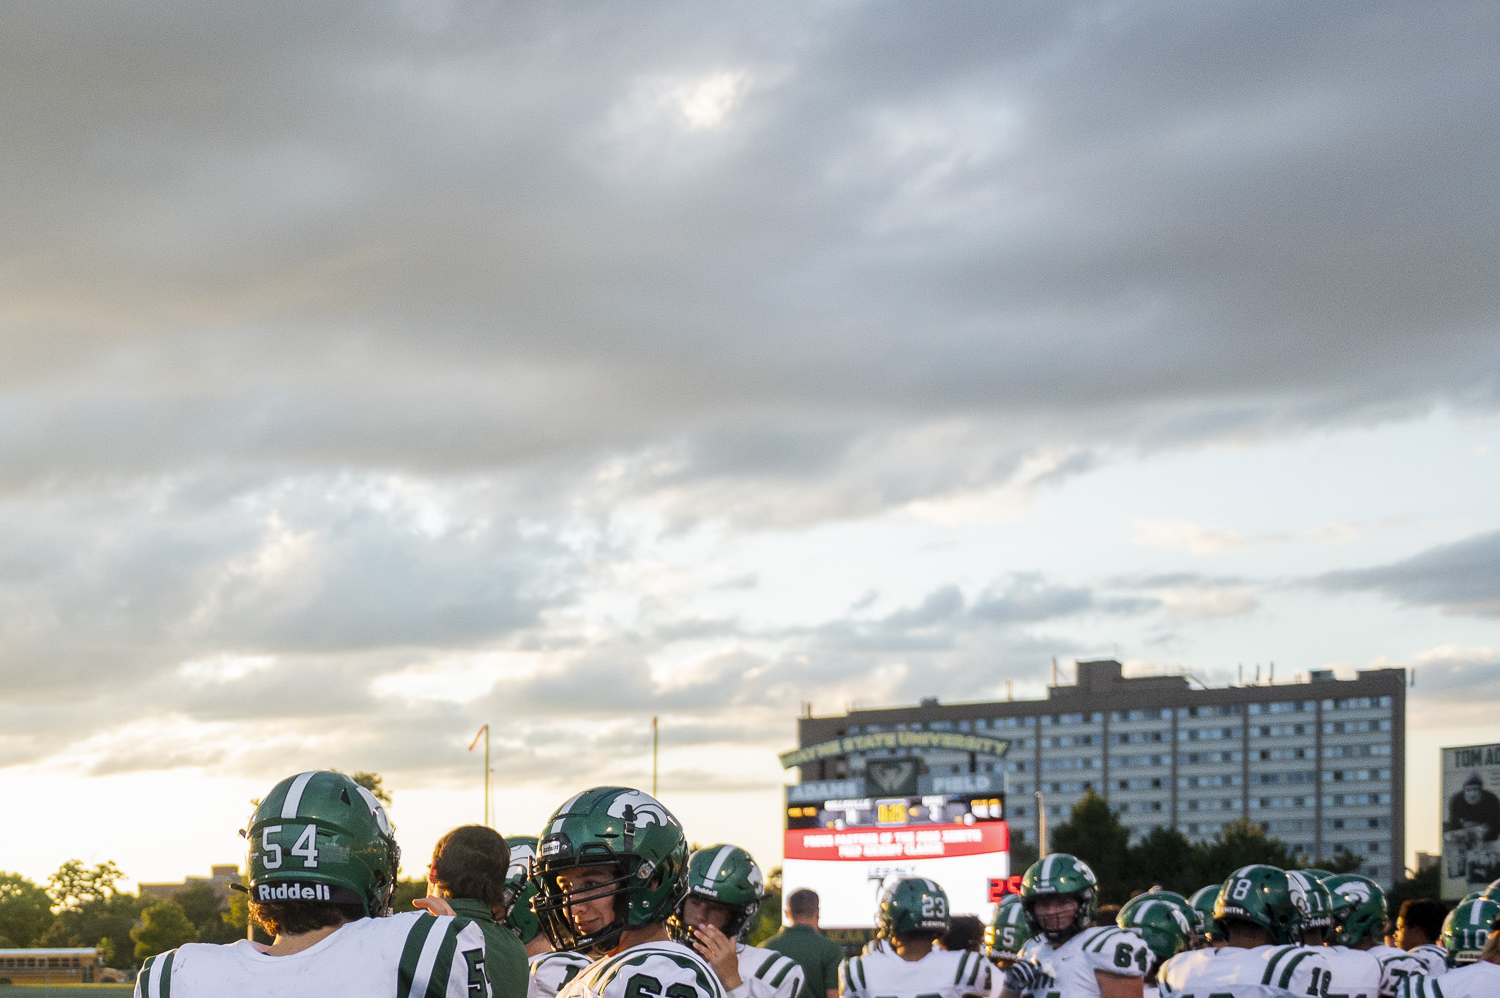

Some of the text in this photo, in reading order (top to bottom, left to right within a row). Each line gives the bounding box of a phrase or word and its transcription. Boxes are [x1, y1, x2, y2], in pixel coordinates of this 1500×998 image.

[782, 731, 1007, 768] WAYNE STATE UNIVERSITY
[789, 782, 858, 802] ADAMS
[932, 775, 990, 795] FIELD
[262, 823, 319, 870] 54
[258, 883, 331, 901] Riddell
[1223, 879, 1252, 901] 18
[922, 895, 946, 918] 23
[1002, 926, 1016, 948] 5
[1113, 943, 1148, 972] 64
[1306, 966, 1332, 998] 18
